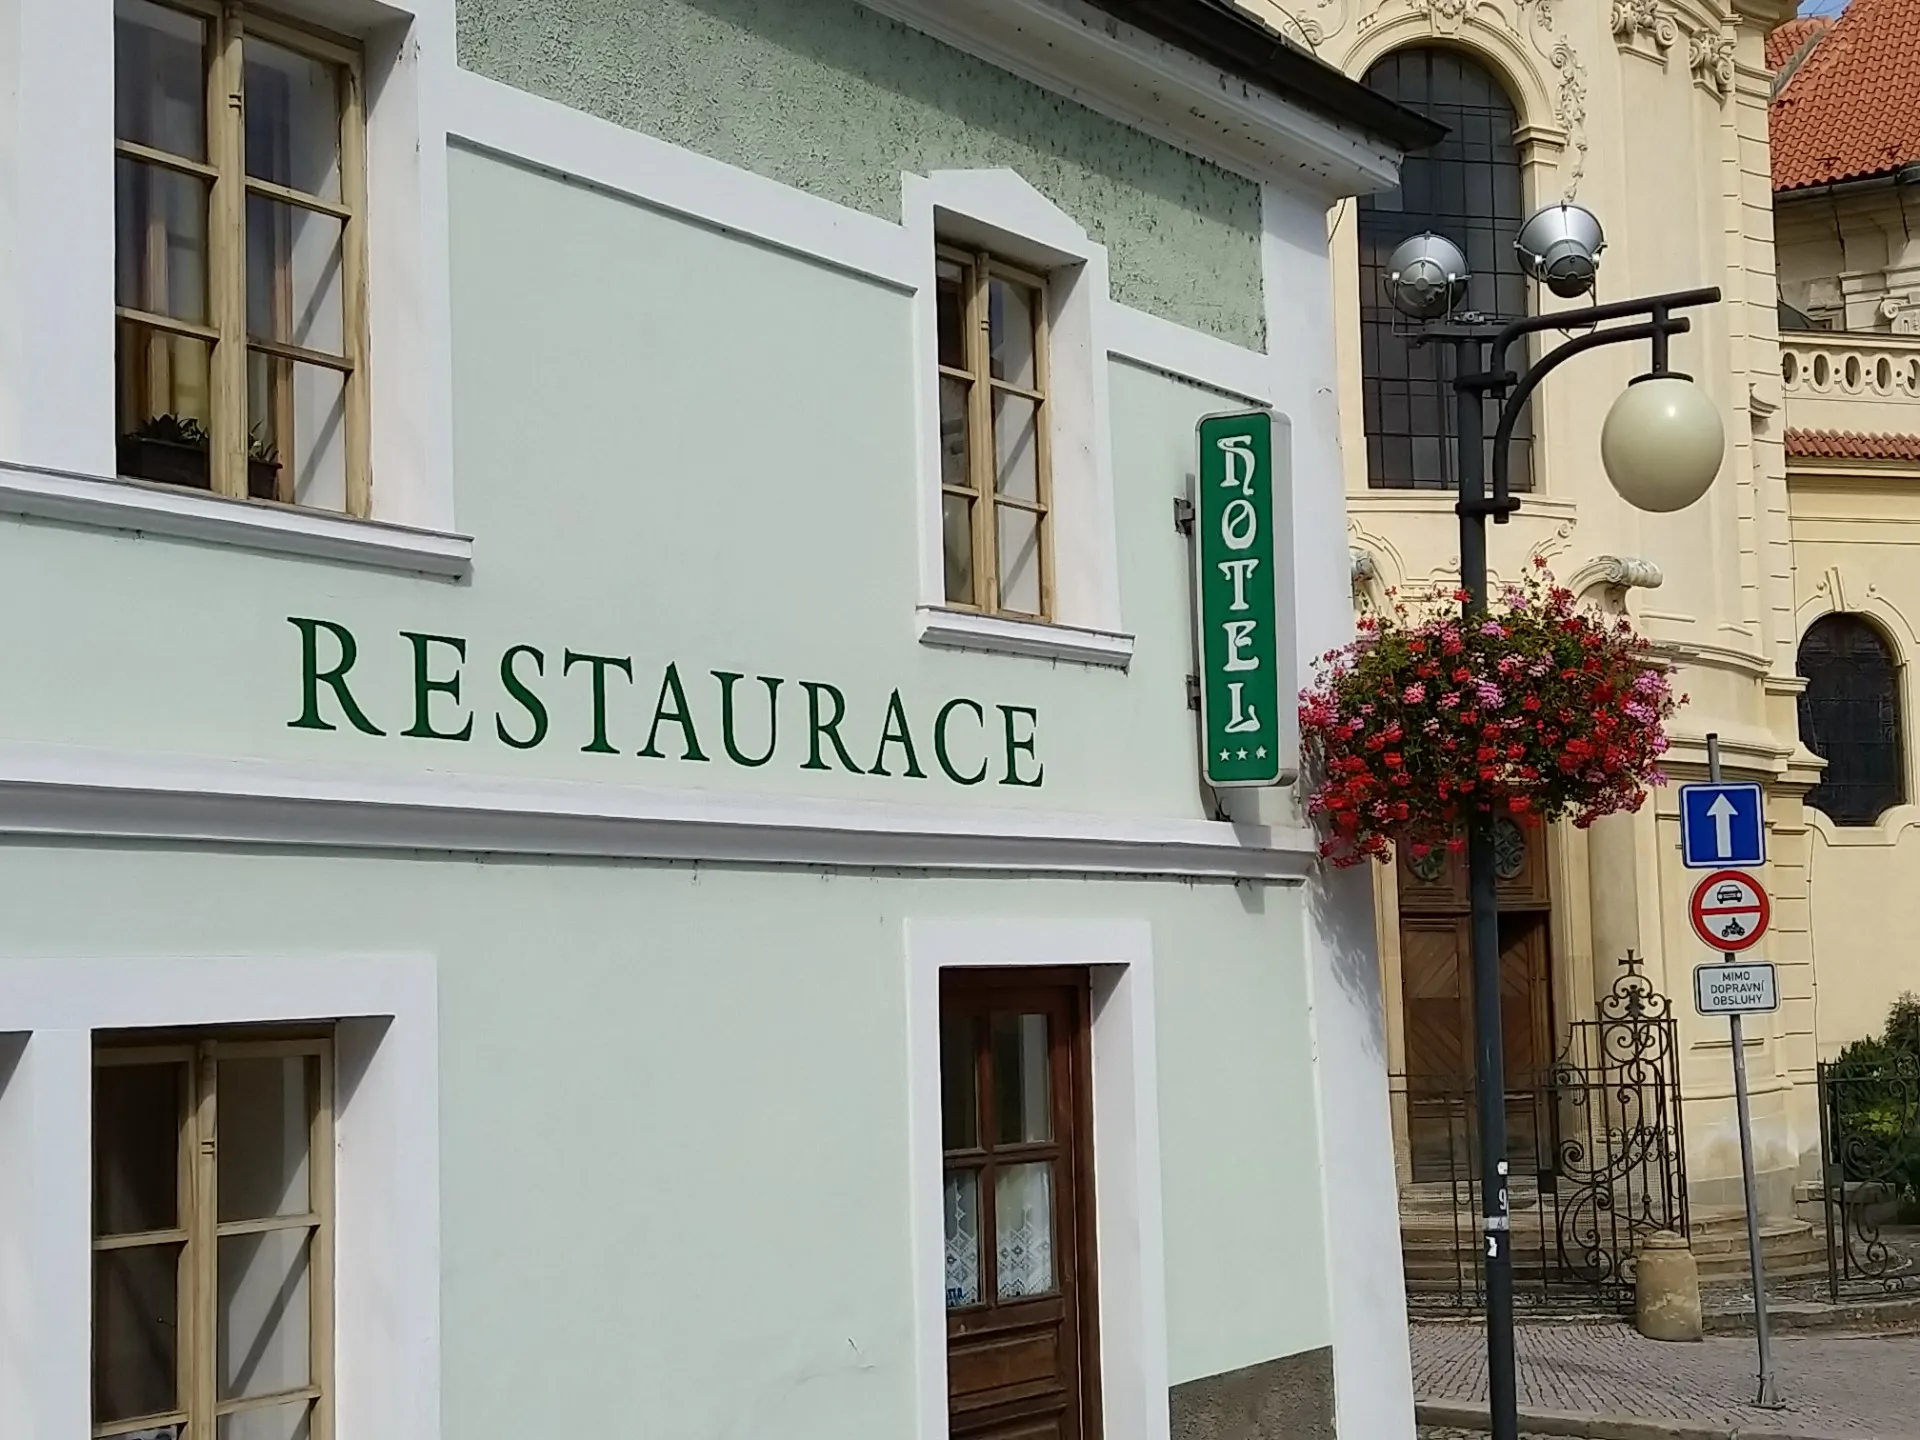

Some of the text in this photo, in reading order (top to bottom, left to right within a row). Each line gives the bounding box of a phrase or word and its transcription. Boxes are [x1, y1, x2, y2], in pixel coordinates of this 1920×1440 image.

[1216, 434, 1261, 734] HOTEL
[287, 616, 1044, 787] RESTAURACE
[1722, 971, 1751, 981] MIMO
[1710, 980, 1764, 994] DOPRAVNÍ
[1713, 994, 1762, 1006] OBSLUHY
